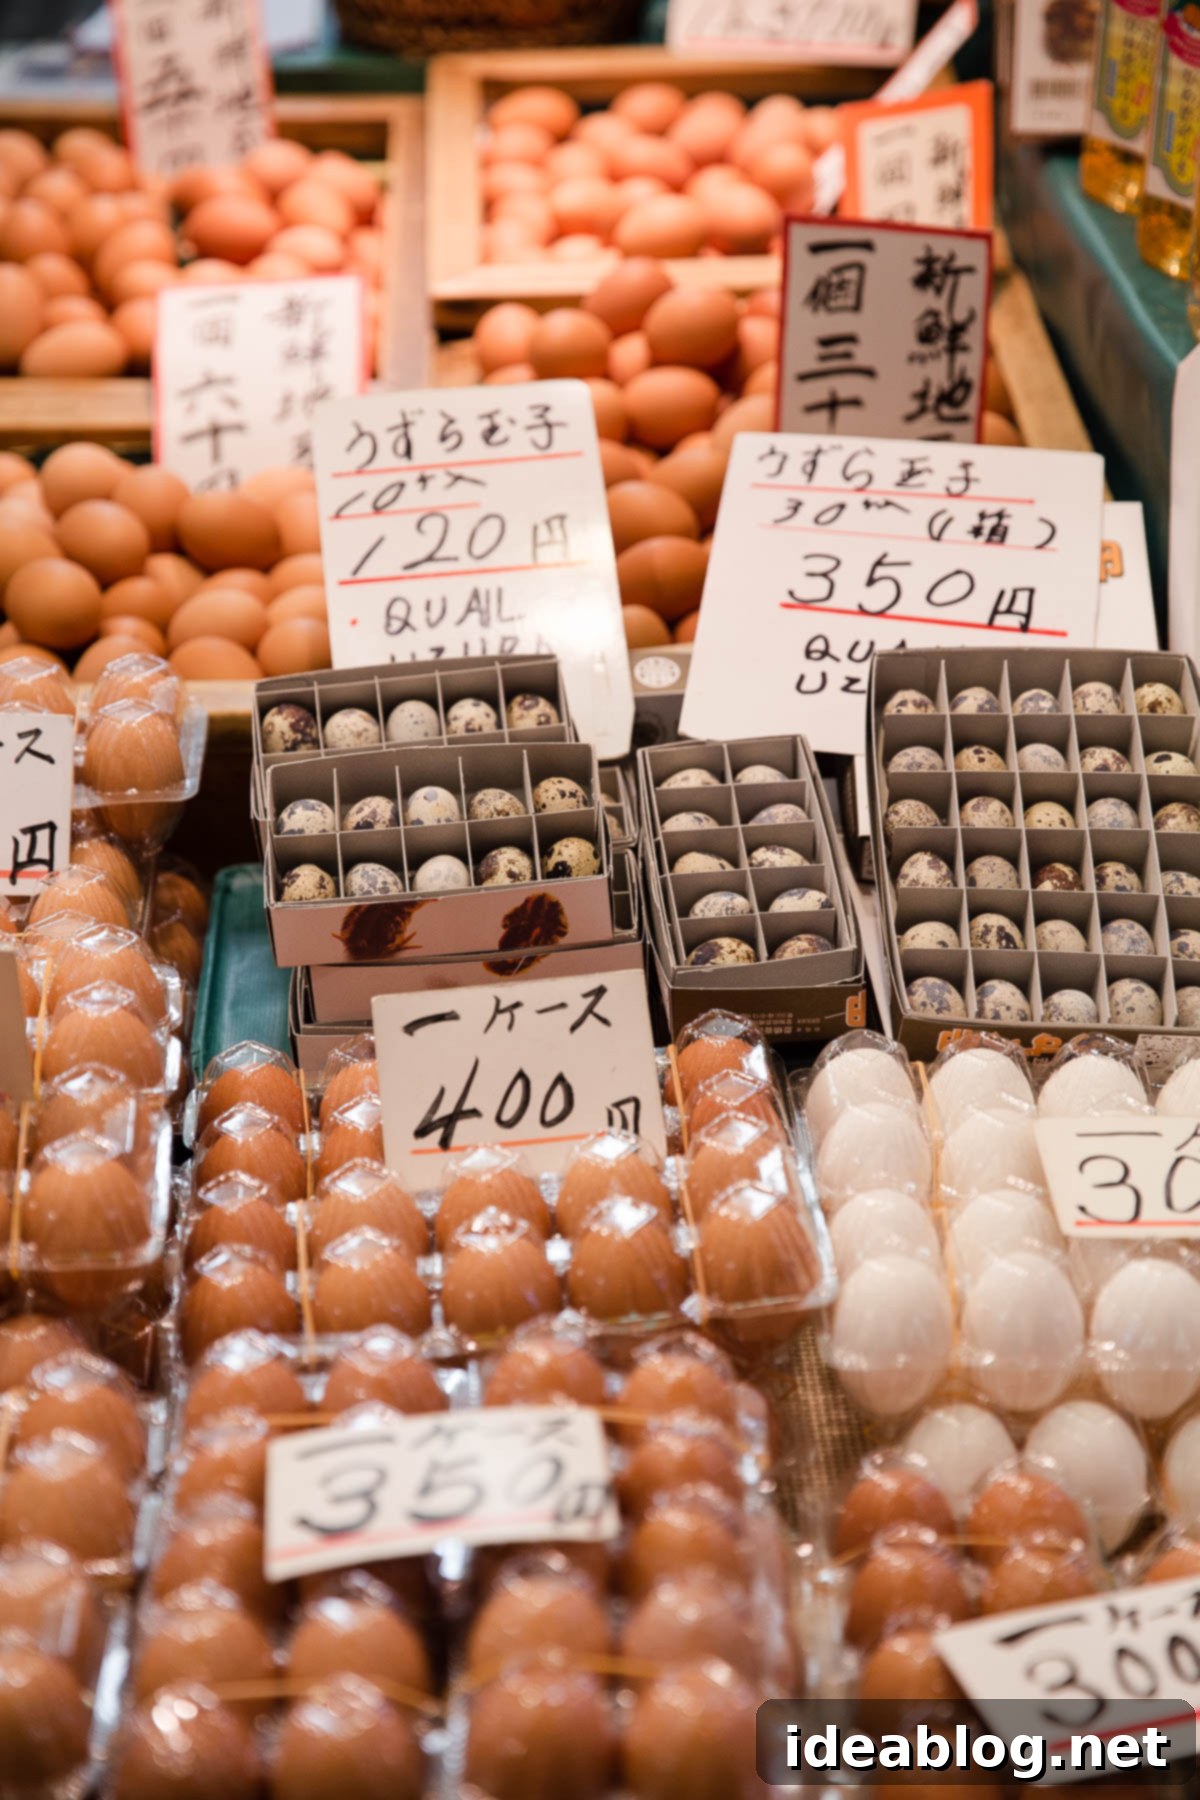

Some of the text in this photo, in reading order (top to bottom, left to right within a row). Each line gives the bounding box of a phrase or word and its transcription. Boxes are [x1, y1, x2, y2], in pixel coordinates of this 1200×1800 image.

[796, 238, 877, 431] 一個三十
[903, 244, 977, 442] 新鮮地
[345, 403, 569, 474] うずら玉子
[758, 444, 981, 498] うずら玉子
[352, 511, 569, 577] 120円
[384, 586, 526, 637] QUAIL
[787, 551, 1037, 633] 350円
[804, 633, 908, 664] QU
[401, 983, 613, 1037] 一ケース
[992, 1592, 1200, 1645] 一ケー
[1024, 1632, 1200, 1729] 300
